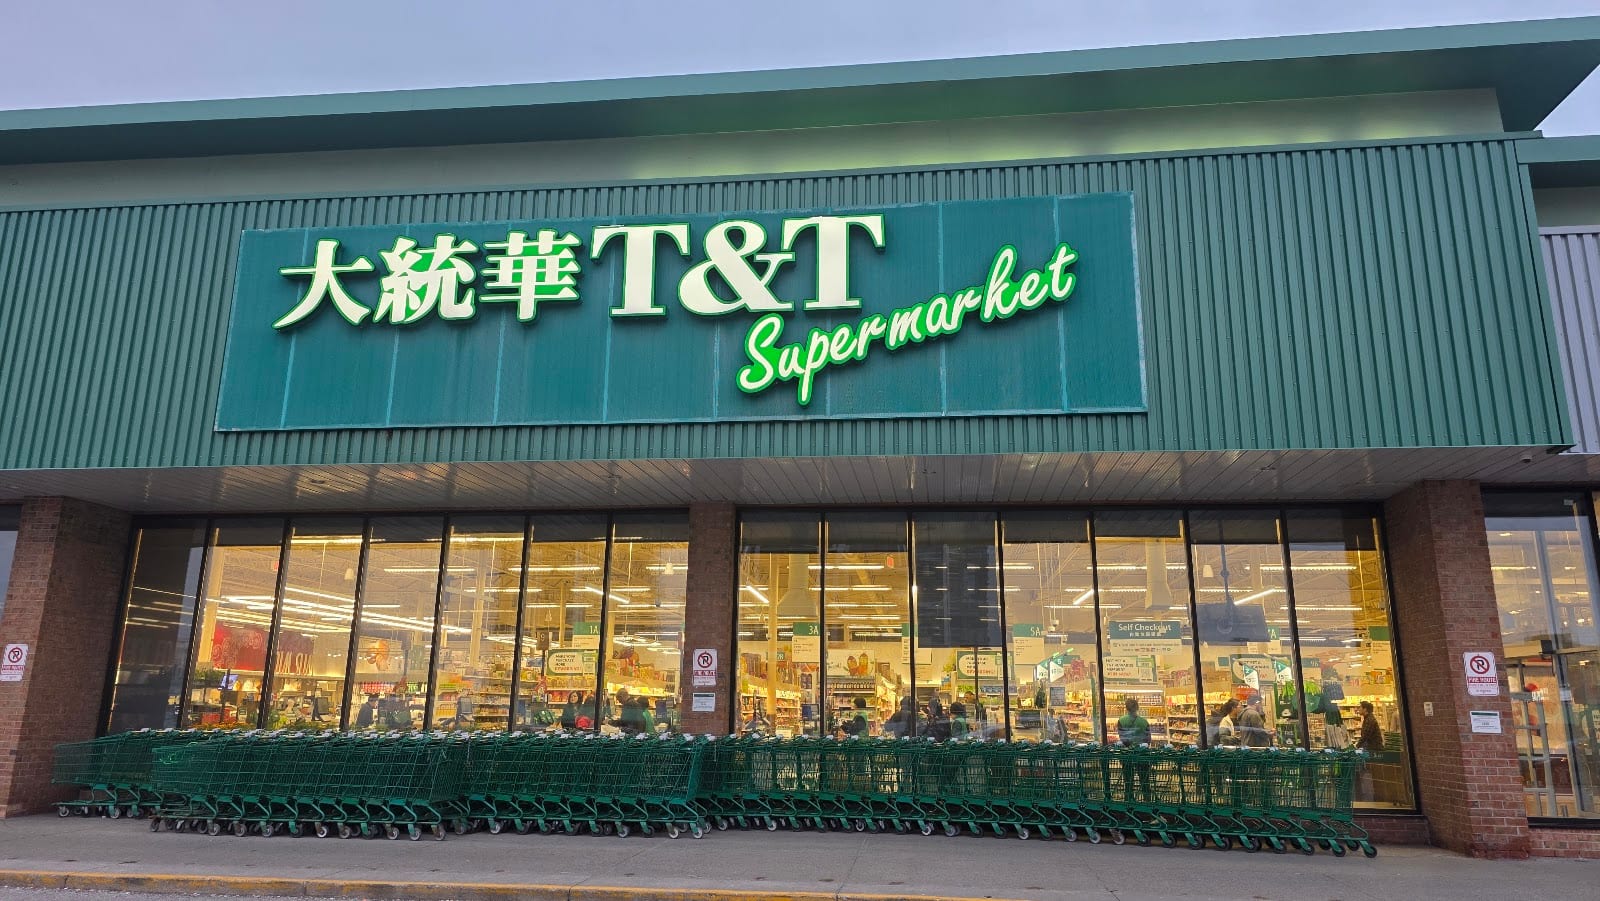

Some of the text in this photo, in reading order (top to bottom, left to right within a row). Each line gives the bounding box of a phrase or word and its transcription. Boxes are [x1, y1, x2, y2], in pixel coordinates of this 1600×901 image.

[272, 228, 581, 328] 大統華
[590, 214, 886, 317] T&T
[736, 243, 1079, 406] Supermarket
[808, 625, 819, 635] 3A
[1118, 623, 1172, 632] Self Checkout
